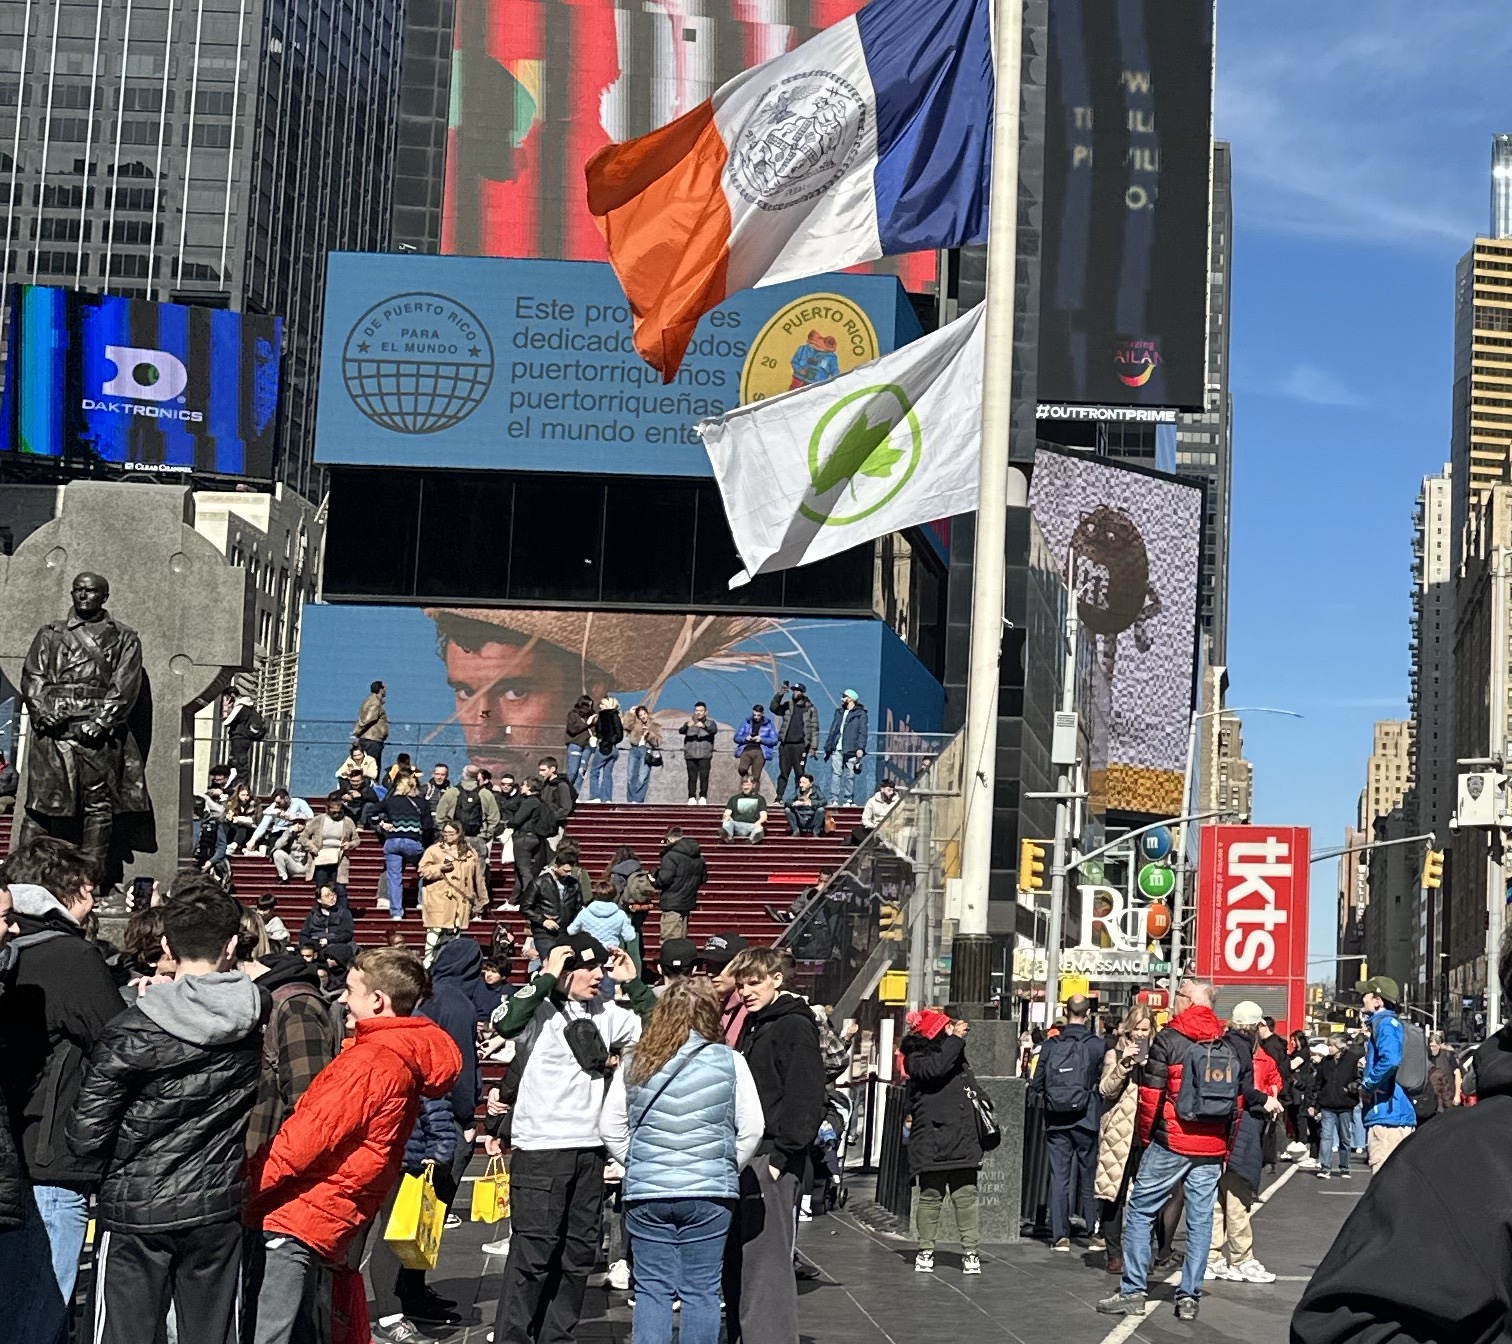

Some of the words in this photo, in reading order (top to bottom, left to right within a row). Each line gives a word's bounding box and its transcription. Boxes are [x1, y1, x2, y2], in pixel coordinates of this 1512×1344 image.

[363, 318, 383, 338] DE
[383, 302, 444, 322] PUERTO
[447, 311, 477, 342] RICO
[515, 296, 575, 321] Este
[585, 304, 634, 328] pro
[710, 309, 742, 329] es
[401, 328, 440, 340] PARA
[512, 326, 635, 354] dedicado
[686, 334, 747, 358] odos
[781, 306, 844, 336] PUERTO
[842, 319, 866, 357] RICO
[381, 341, 399, 353] EL
[404, 342, 458, 355] MUNDO
[511, 359, 726, 389] puertorriquños
[760, 355, 778, 370] 20
[82, 398, 203, 423] DAKTRONICS
[509, 389, 725, 419] puertorriqueñas
[1035, 403, 1177, 423] #OUTFRONTPRIME
[507, 416, 531, 439] el
[541, 419, 635, 444] mundo
[1146, 836, 1159, 849] m
[1149, 872, 1164, 886] m
[1224, 836, 1293, 973] tkts
[1154, 914, 1167, 927] m
